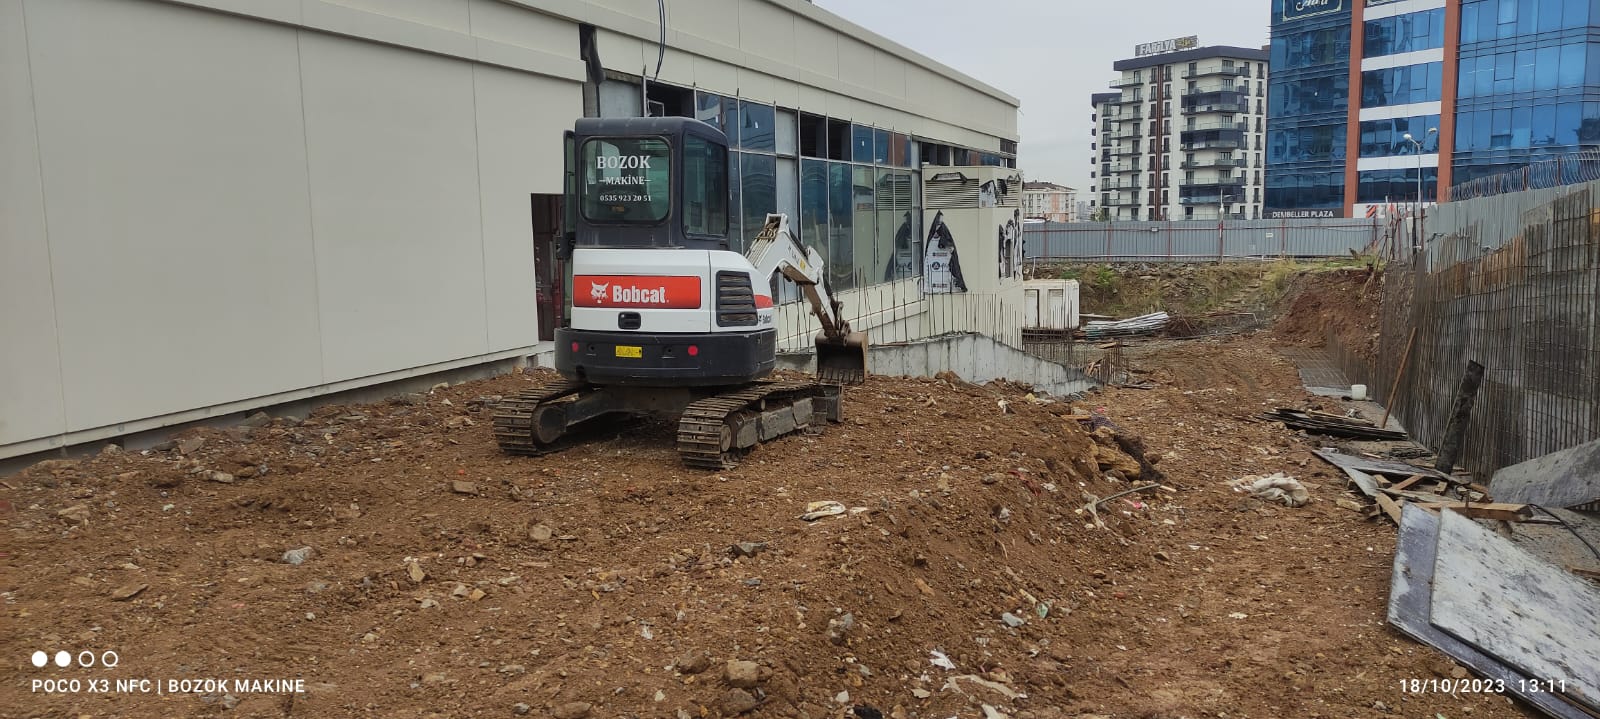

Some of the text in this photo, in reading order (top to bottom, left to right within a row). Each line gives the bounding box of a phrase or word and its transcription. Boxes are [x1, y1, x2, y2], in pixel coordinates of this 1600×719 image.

[597, 155, 651, 169] BOZOK
[600, 194, 651, 202] 0535 923 20 51
[1310, 210, 1334, 218] PLAZA
[612, 285, 666, 303] Bobcat
